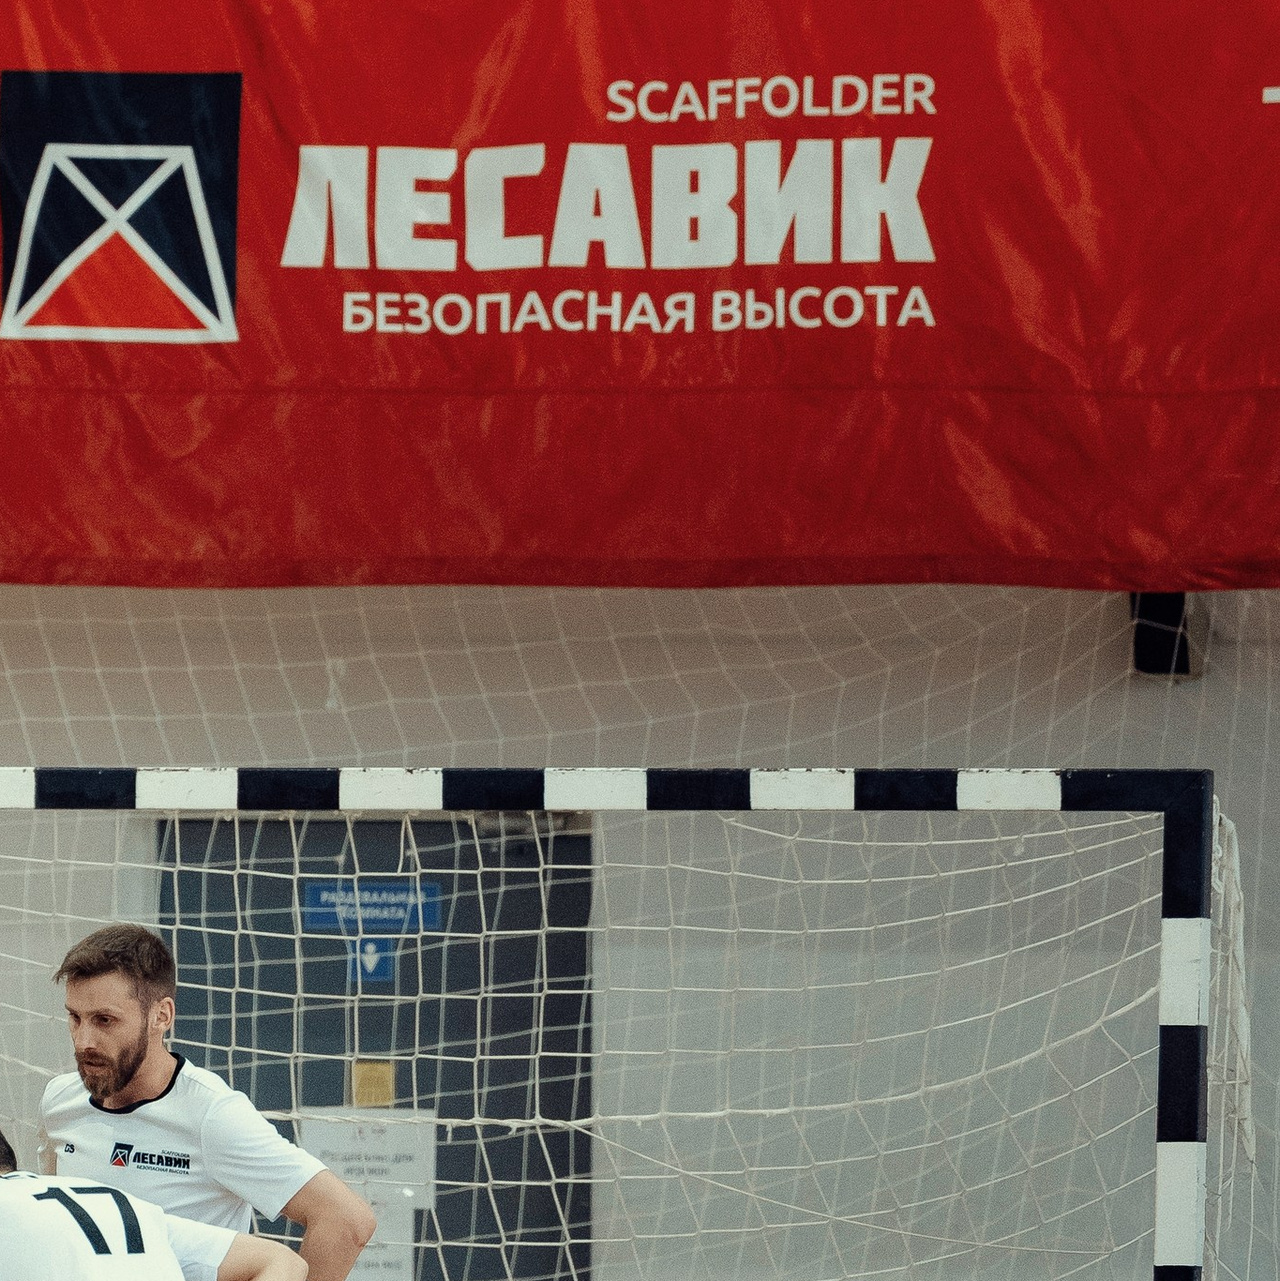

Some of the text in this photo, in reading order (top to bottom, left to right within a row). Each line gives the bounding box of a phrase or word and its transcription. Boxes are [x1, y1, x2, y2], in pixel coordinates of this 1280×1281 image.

[605, 74, 937, 124] SCAFFOLDER
[281, 136, 936, 272] ЛЕСАВИК
[342, 285, 937, 336] БЕЗОПАСНАЯ ВЫСОТА
[132, 1151, 191, 1170] ЛЕСАВИК
[32, 1186, 146, 1256] 17
